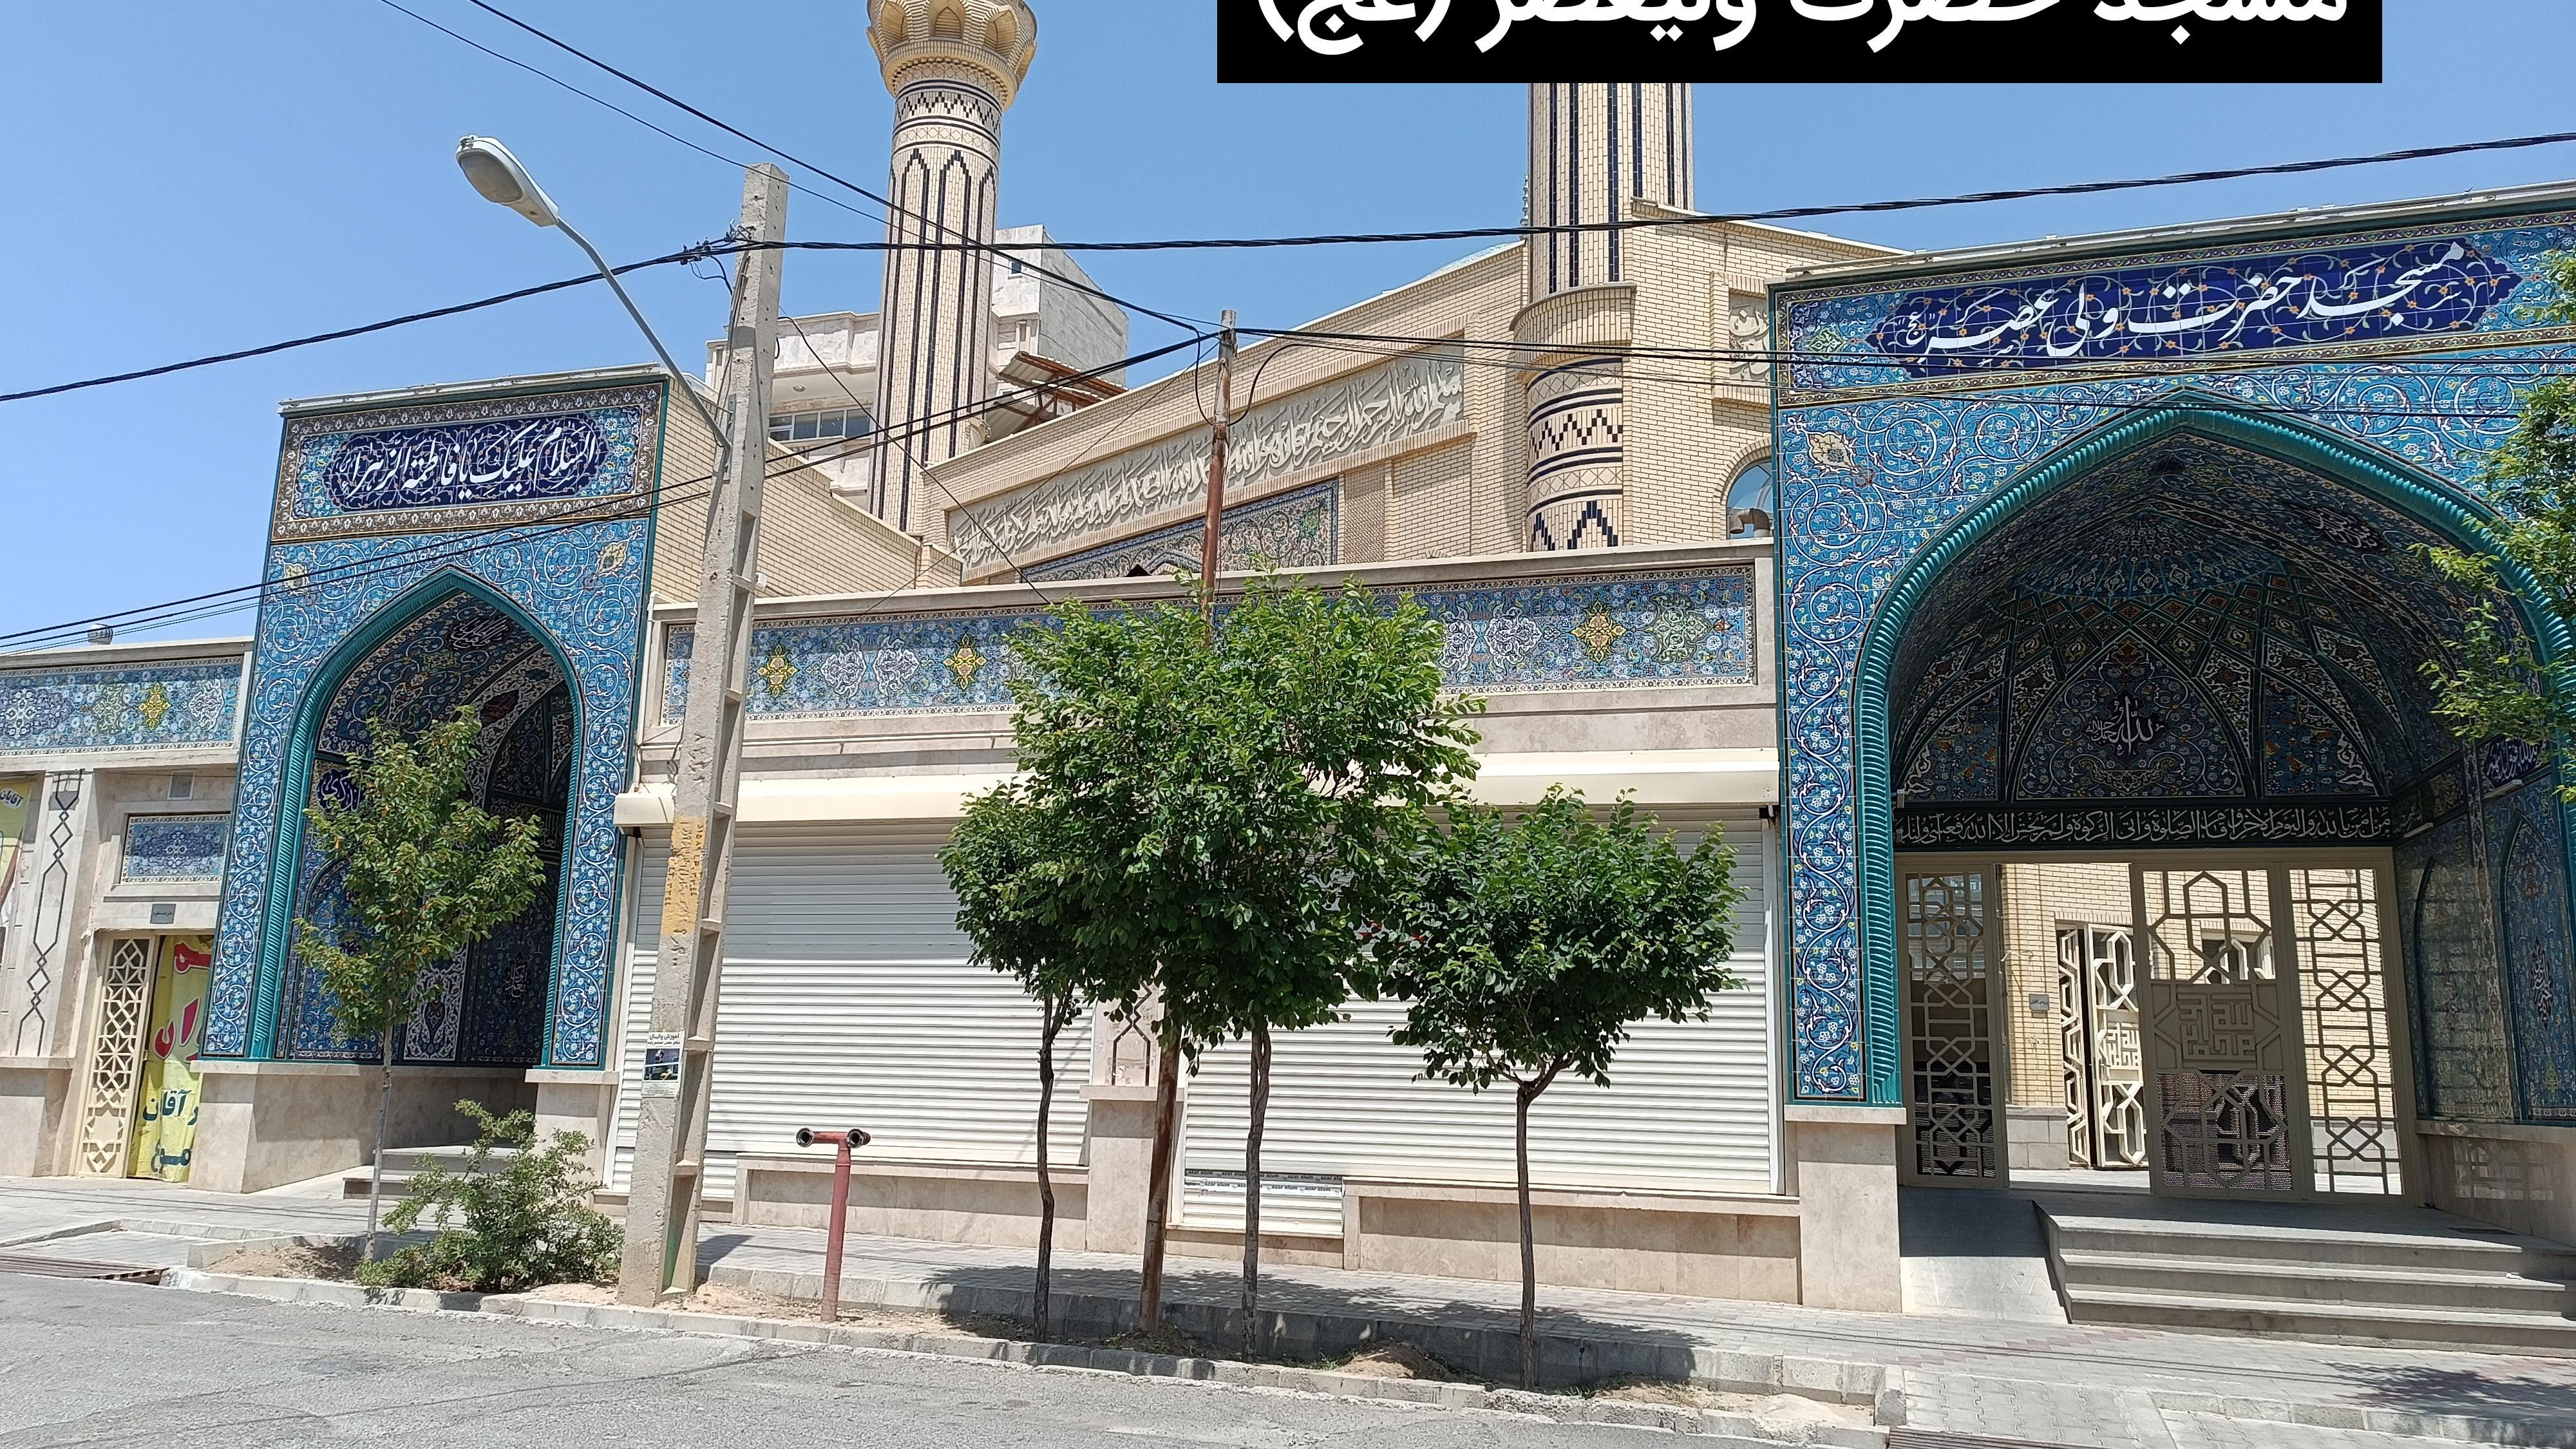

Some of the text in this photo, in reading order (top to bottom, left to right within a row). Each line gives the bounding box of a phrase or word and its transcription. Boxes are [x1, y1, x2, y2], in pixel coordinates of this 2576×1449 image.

[2047, 283, 2118, 356] ولی
[2128, 275, 2302, 341] حضرت
[2296, 242, 2464, 326] مسجد
[1917, 289, 2059, 364] عصر
[469, 420, 541, 492] علیک
[533, 426, 596, 491] السلام
